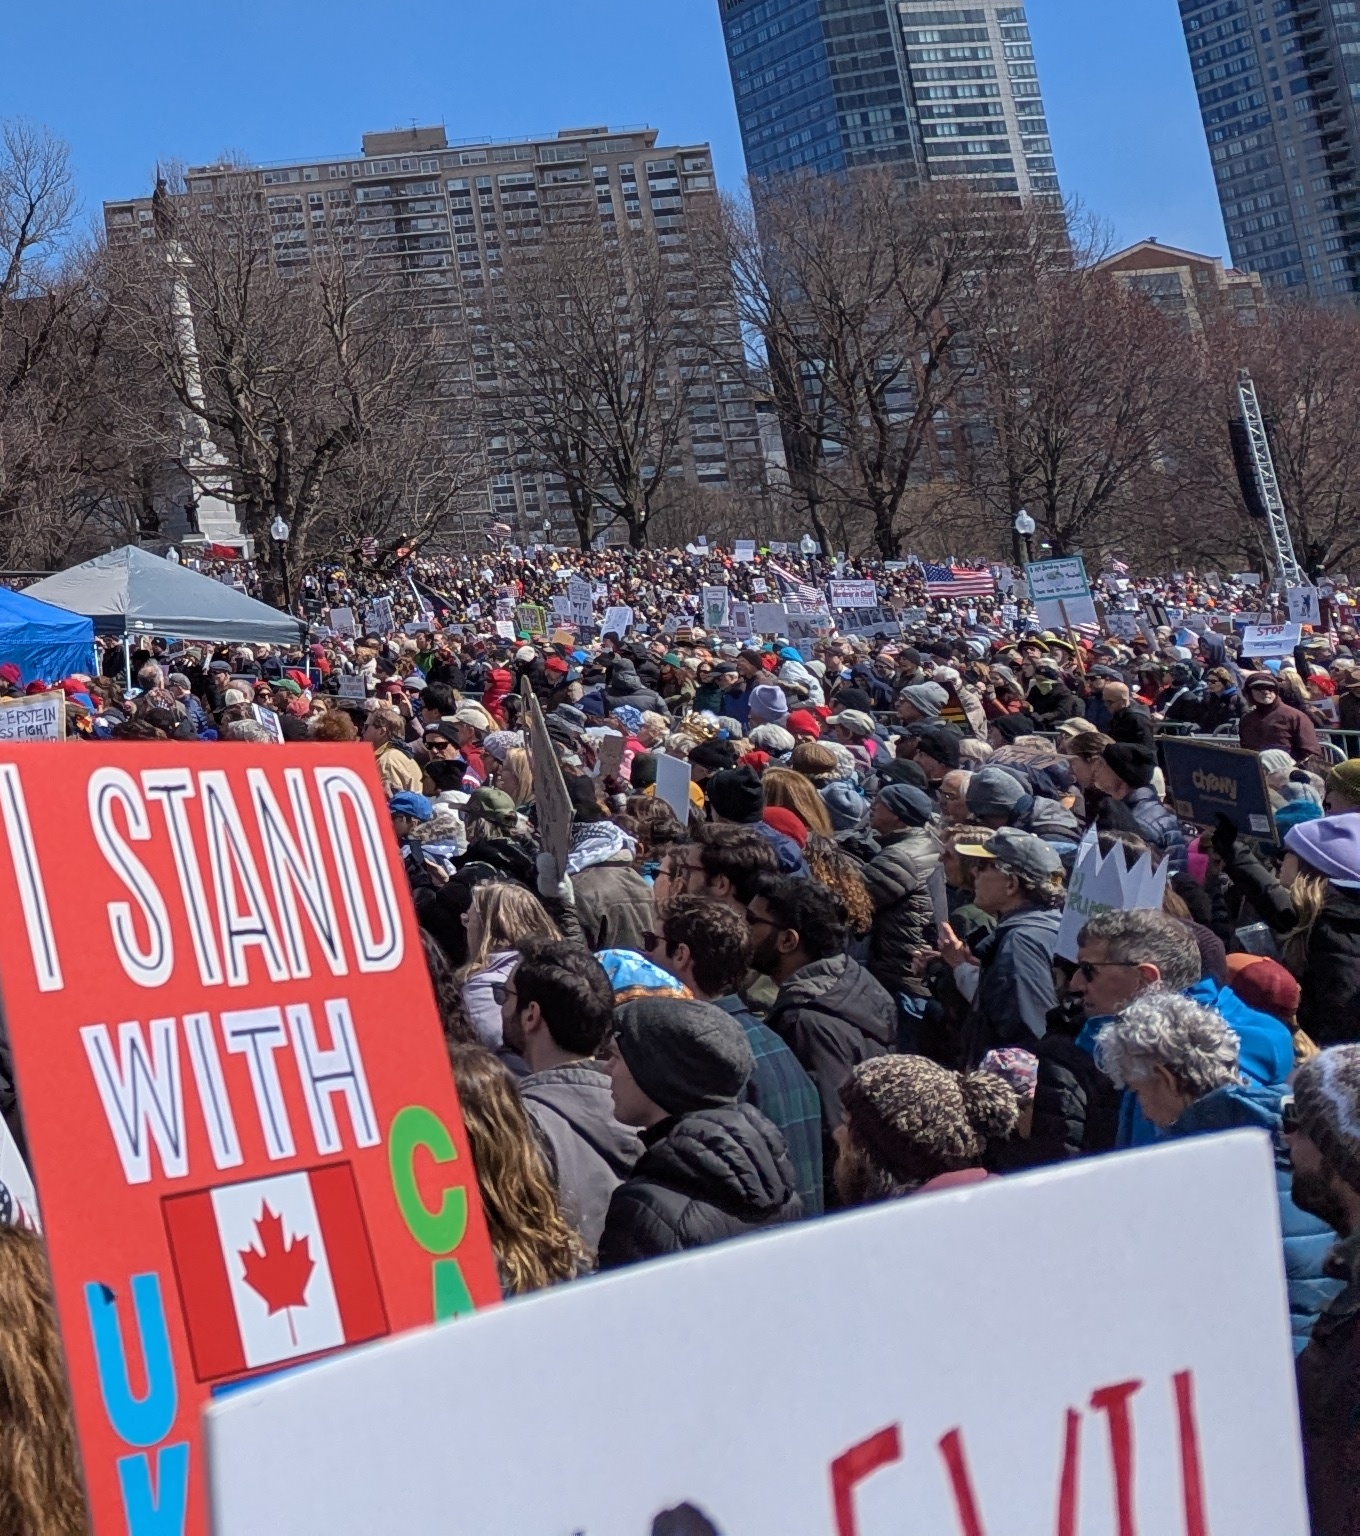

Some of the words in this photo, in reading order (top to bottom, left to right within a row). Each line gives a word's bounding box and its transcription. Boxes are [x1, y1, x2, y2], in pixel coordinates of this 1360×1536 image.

[1256, 625, 1285, 637] STOP
[6, 706, 56, 725] EPSTEIN
[16, 722, 53, 738] FIGHT
[1191, 767, 1238, 800] chewy
[86, 766, 404, 989] STAND
[79, 997, 382, 1185] WITH
